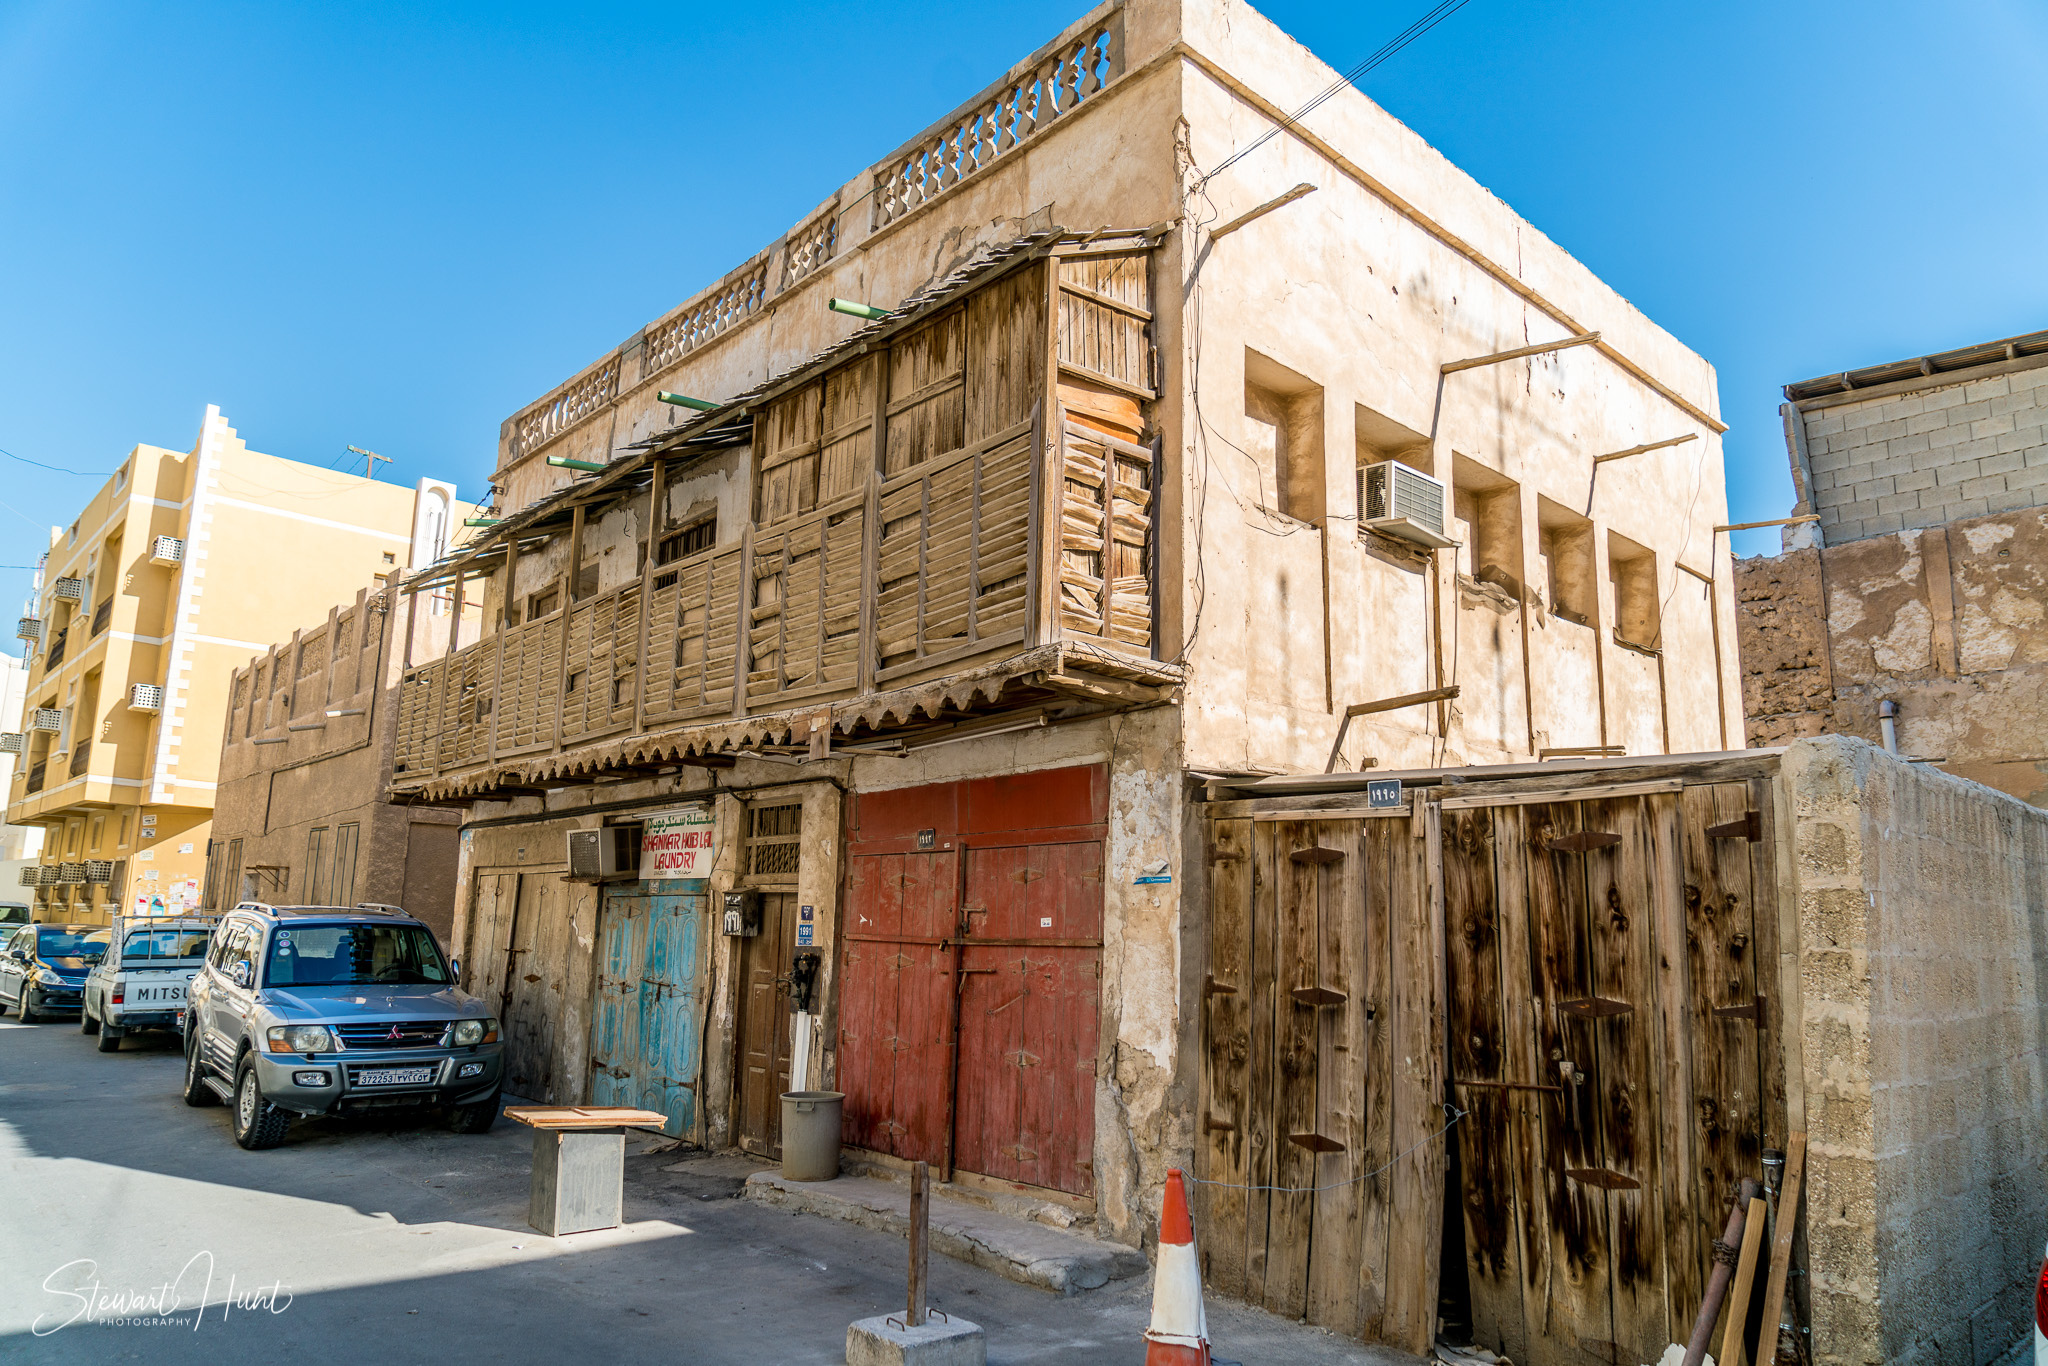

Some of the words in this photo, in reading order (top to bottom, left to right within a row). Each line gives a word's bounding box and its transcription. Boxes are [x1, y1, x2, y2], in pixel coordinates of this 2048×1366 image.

[654, 851, 697, 870] LAUNDRY
[799, 926, 812, 936] 1991
[361, 1075, 394, 1084] 372253
[397, 1073, 429, 1083] ٣٧٢٢٥٣
